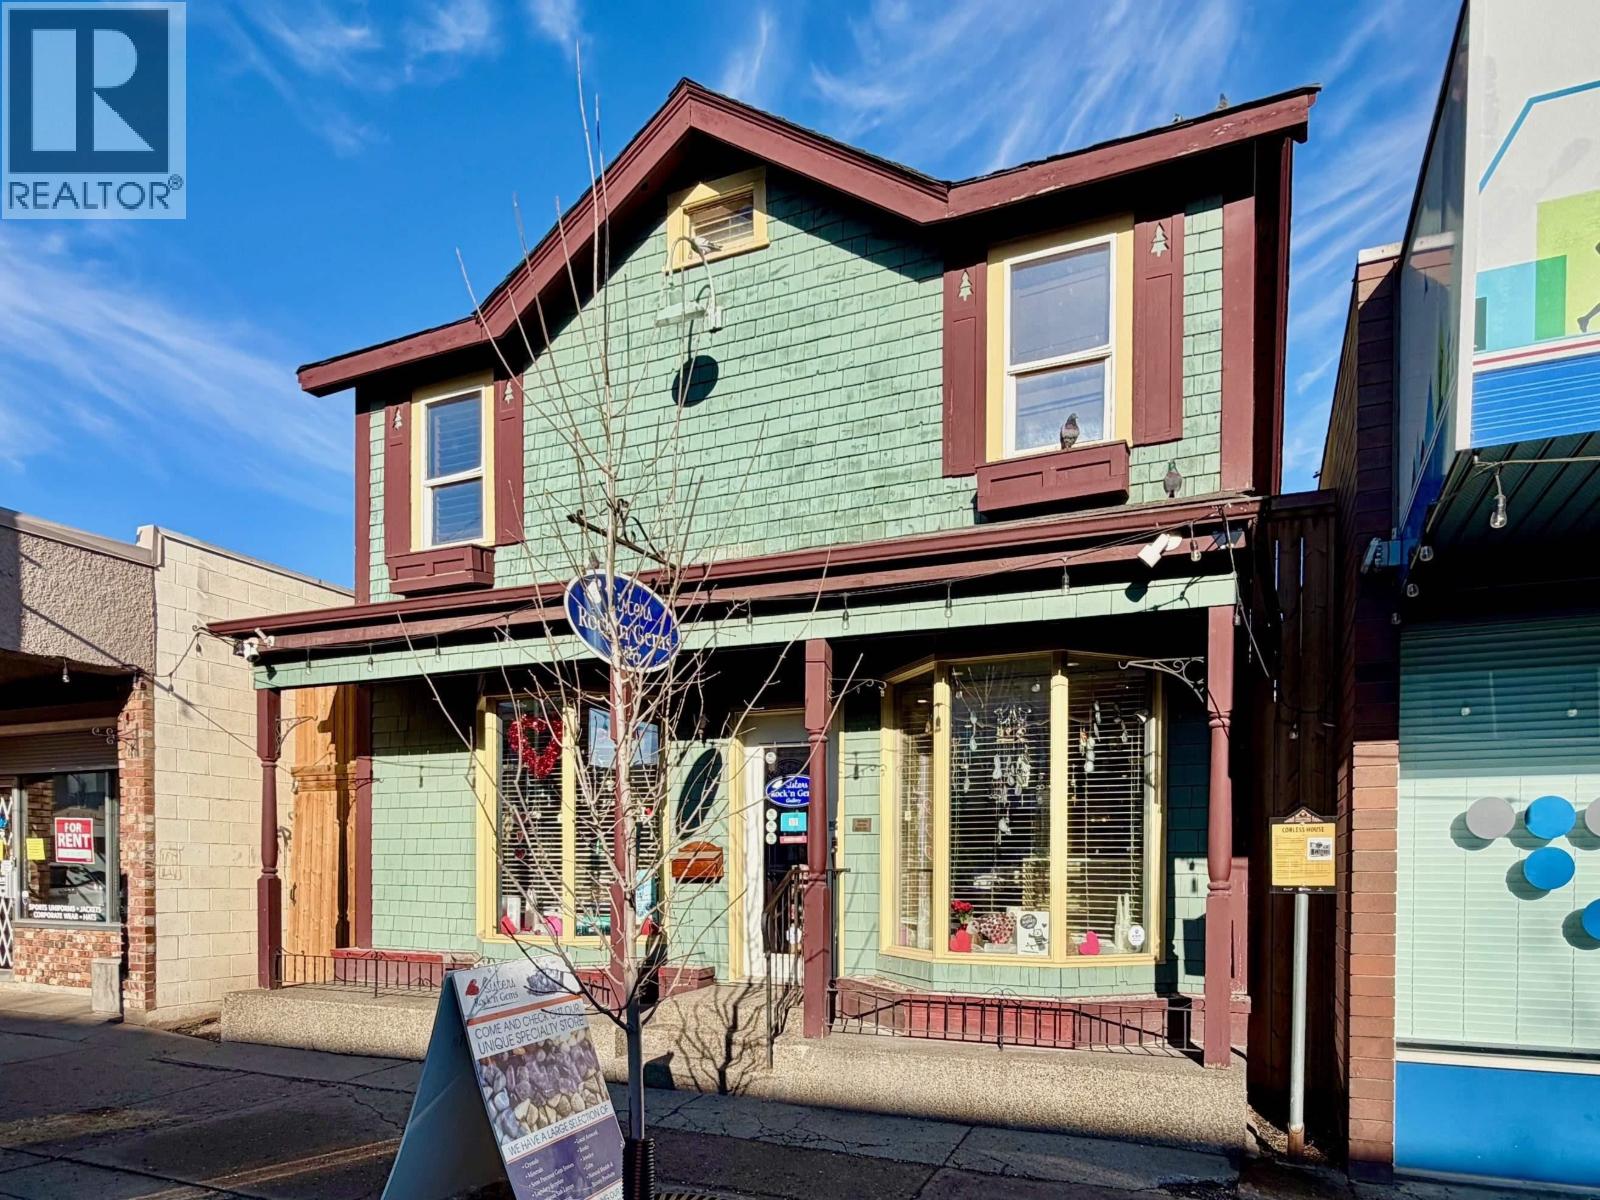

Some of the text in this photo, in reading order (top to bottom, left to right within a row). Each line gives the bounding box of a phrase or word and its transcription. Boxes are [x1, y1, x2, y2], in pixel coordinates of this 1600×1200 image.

[786, 780, 808, 788] Sisters
[64, 822, 82, 833] FOR
[58, 833, 91, 848] RENT
[500, 991, 518, 1002] Gems
[474, 1026, 502, 1040] COME
[504, 1020, 522, 1032] AND
[522, 1012, 548, 1026] CHECK
[564, 1003, 580, 1015] OUR
[478, 1015, 585, 1054] UNIQUE SPECIALTY STORE
[508, 1145, 519, 1156] WE
[522, 1136, 542, 1151] HAVE
[548, 1124, 568, 1138] LARGE
[569, 1110, 600, 1130] SELECTION
[600, 1104, 609, 1114] OF
